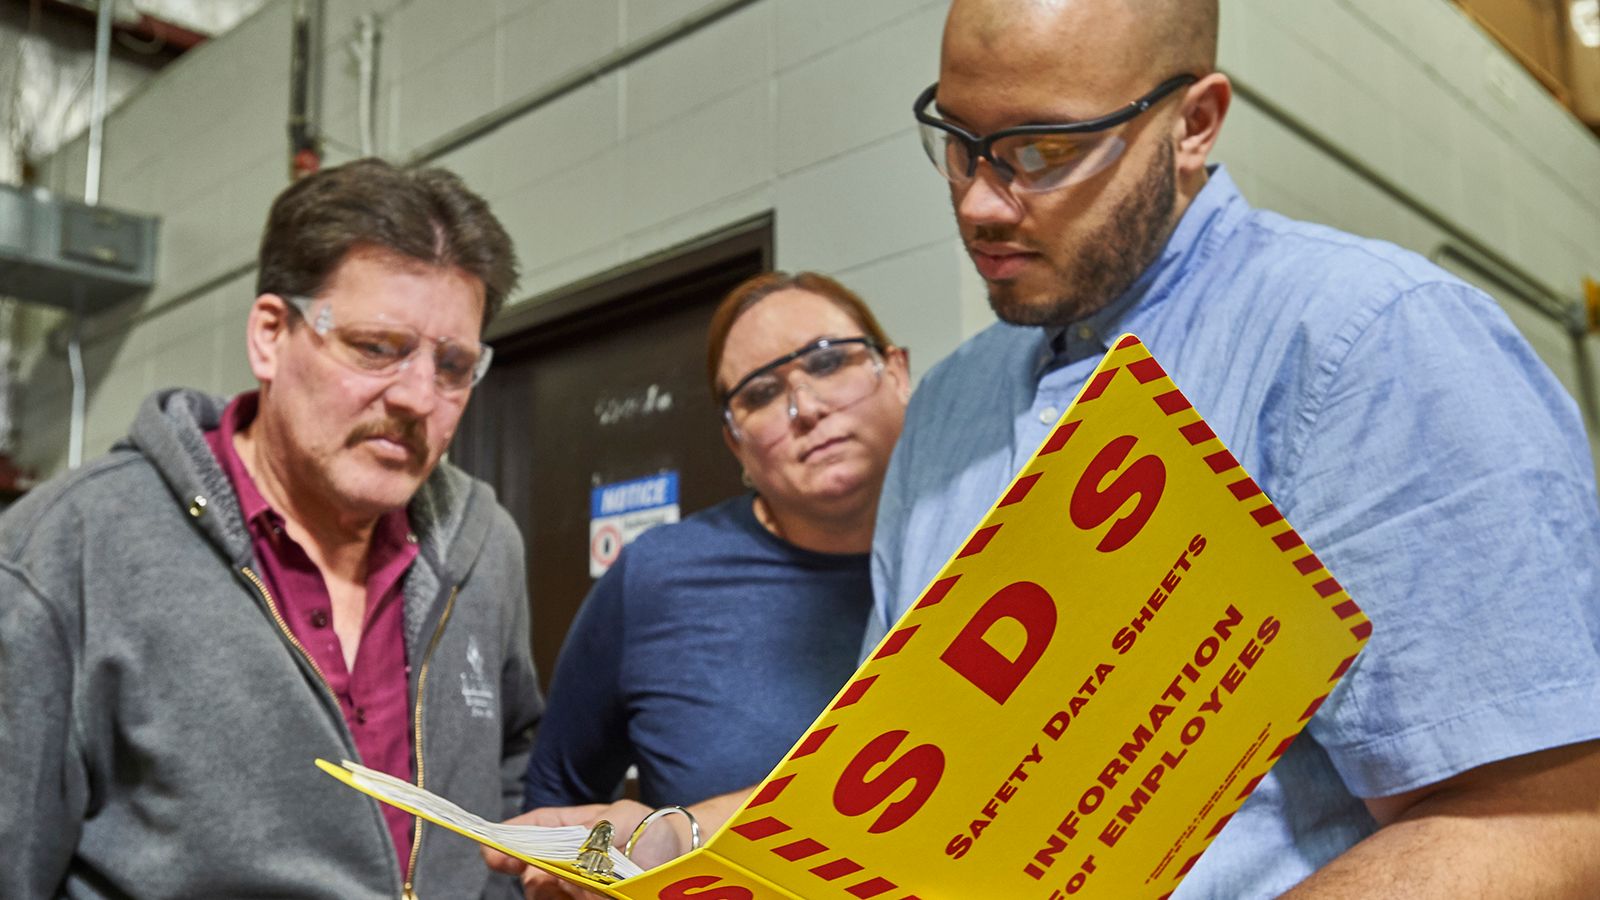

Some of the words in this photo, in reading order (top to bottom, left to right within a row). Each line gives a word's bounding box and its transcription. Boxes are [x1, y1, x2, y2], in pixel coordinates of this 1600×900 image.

[601, 477, 667, 514] NOTICE
[945, 743, 1044, 860] SAFETY
[1042, 663, 1116, 741] DATA
[1111, 534, 1207, 655] SHEETS
[1023, 604, 1244, 880] INFORMATION
[1098, 616, 1280, 848] EMPLOYEES
